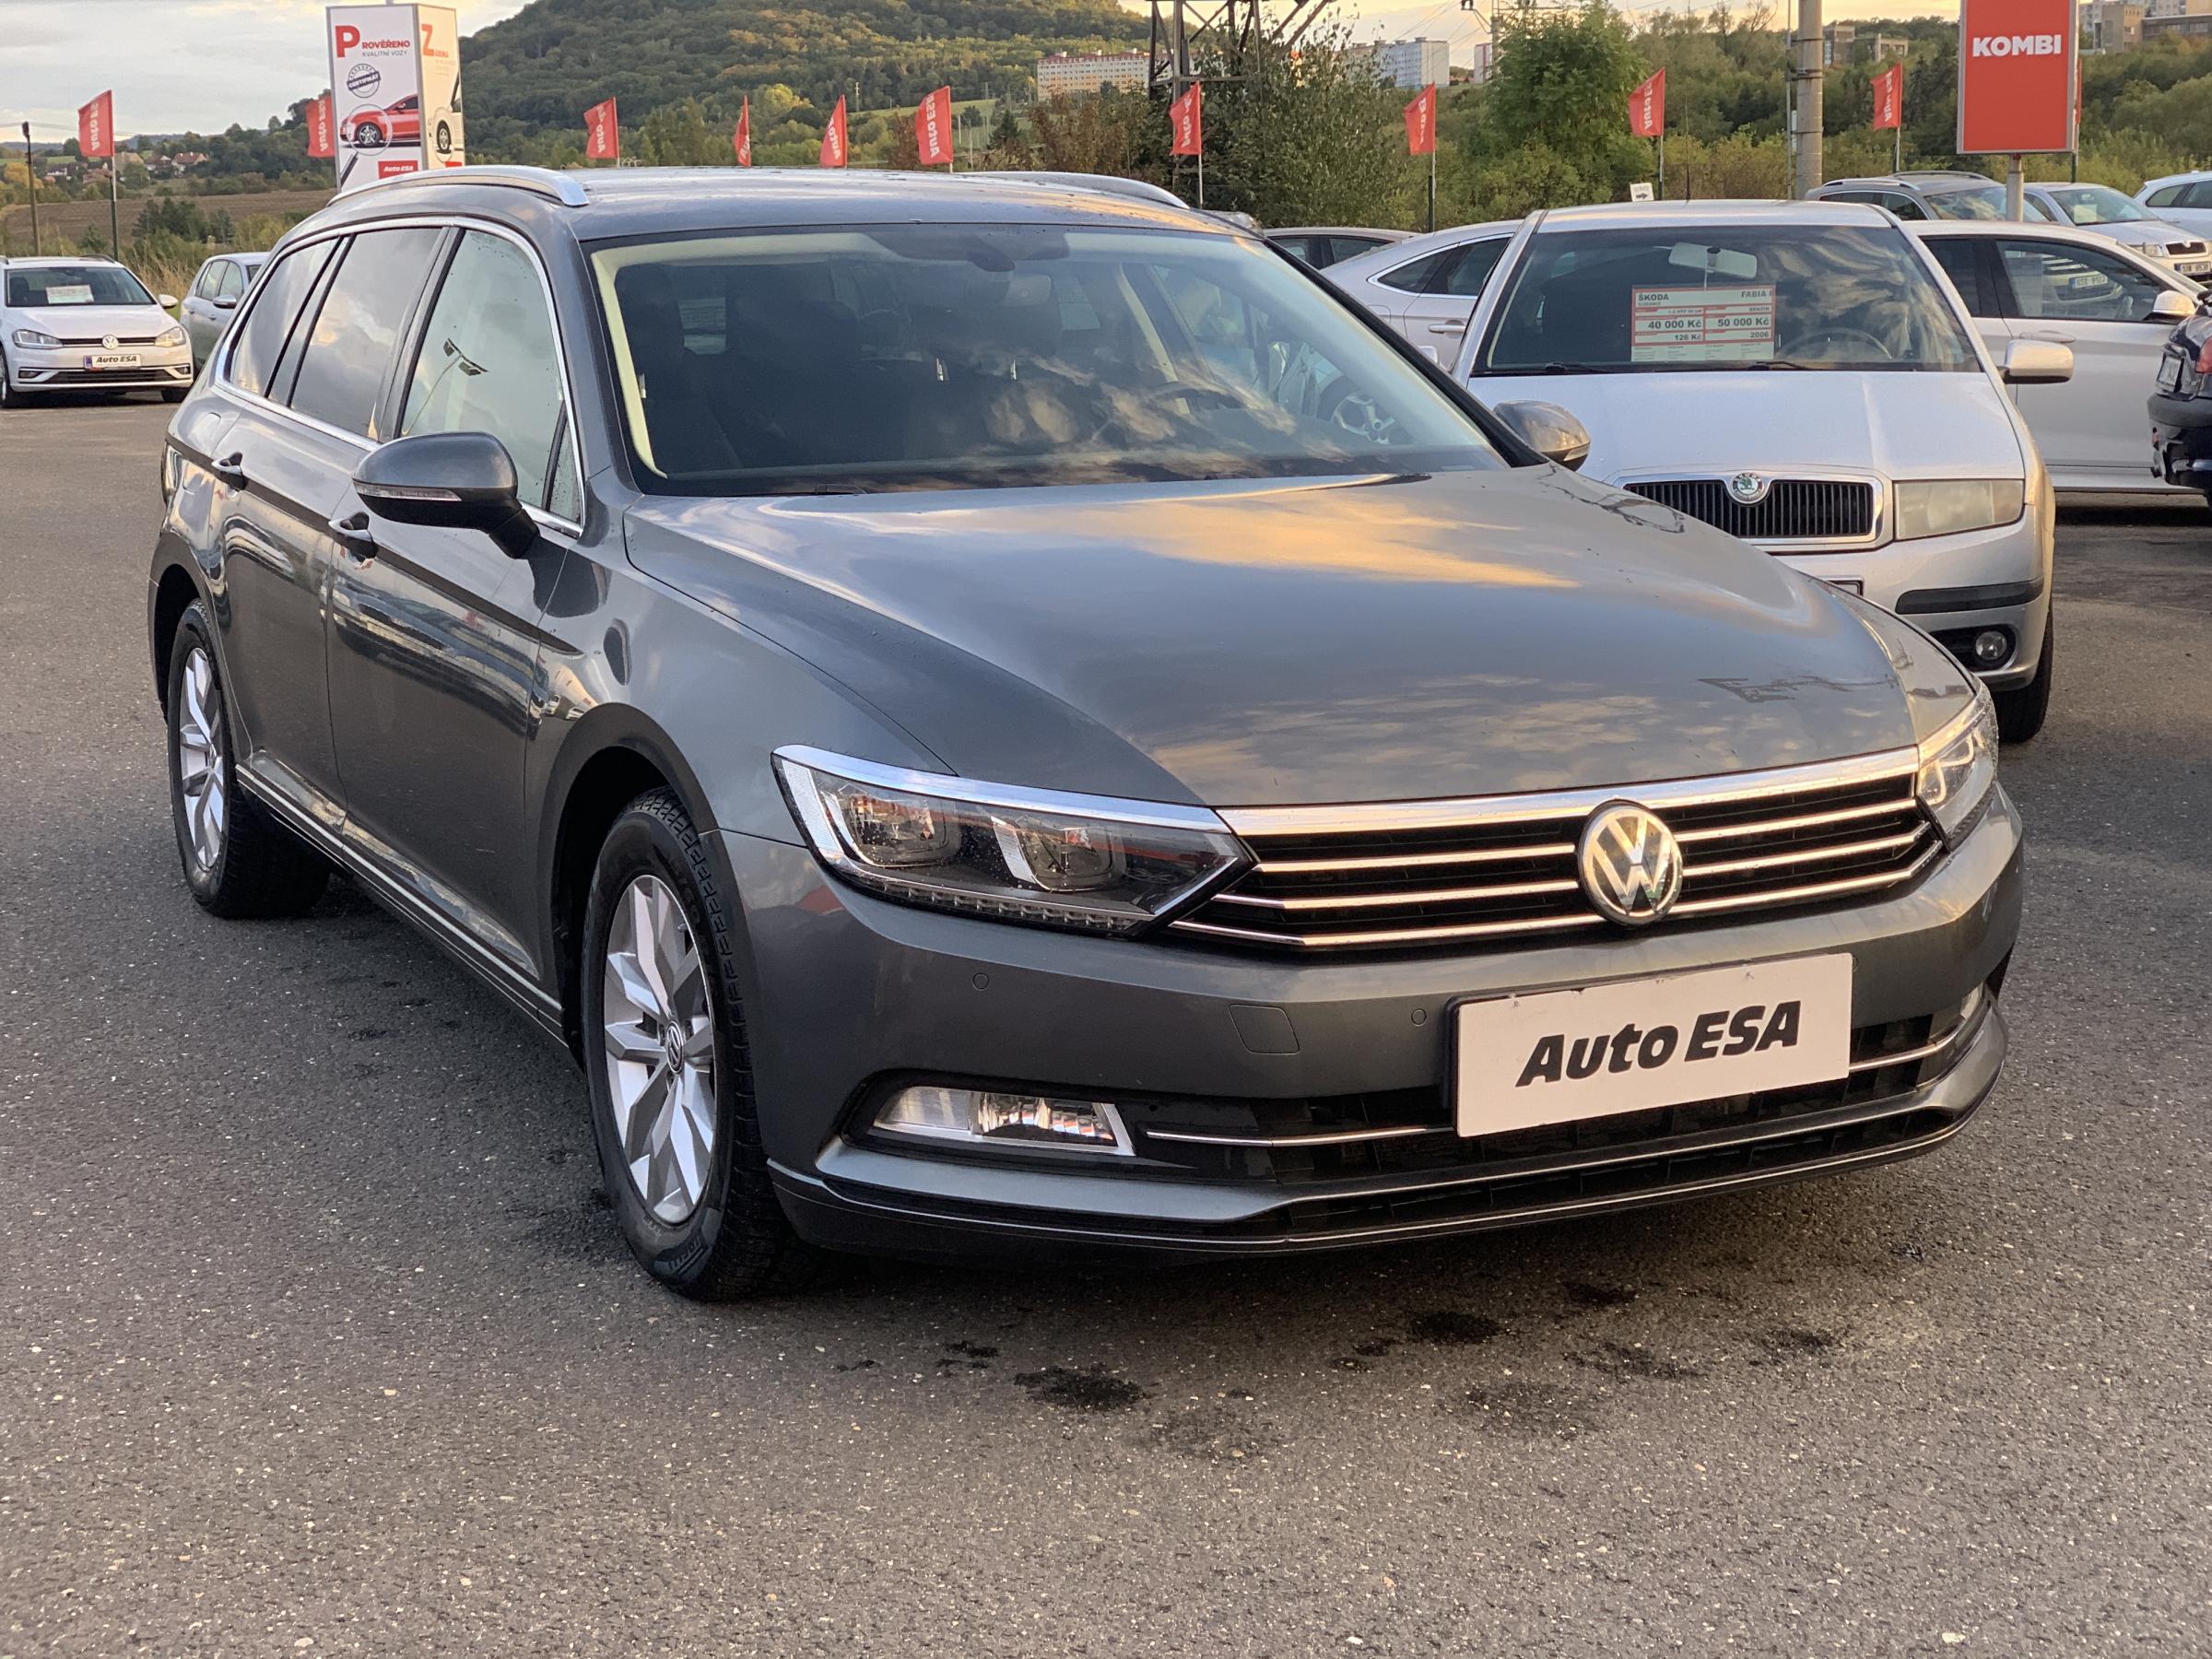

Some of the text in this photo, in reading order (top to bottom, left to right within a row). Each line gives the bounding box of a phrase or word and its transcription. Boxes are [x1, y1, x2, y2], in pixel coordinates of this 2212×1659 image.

[1972, 34, 2062, 57] KOMBI
[1638, 292, 1669, 301] ŠKODA
[1741, 290, 1767, 299] FABIA
[1648, 319, 1701, 329] 40 000 Kč
[1717, 317, 1770, 327] 50 000 Kč
[1514, 1000, 1802, 1088] Auto ESA
